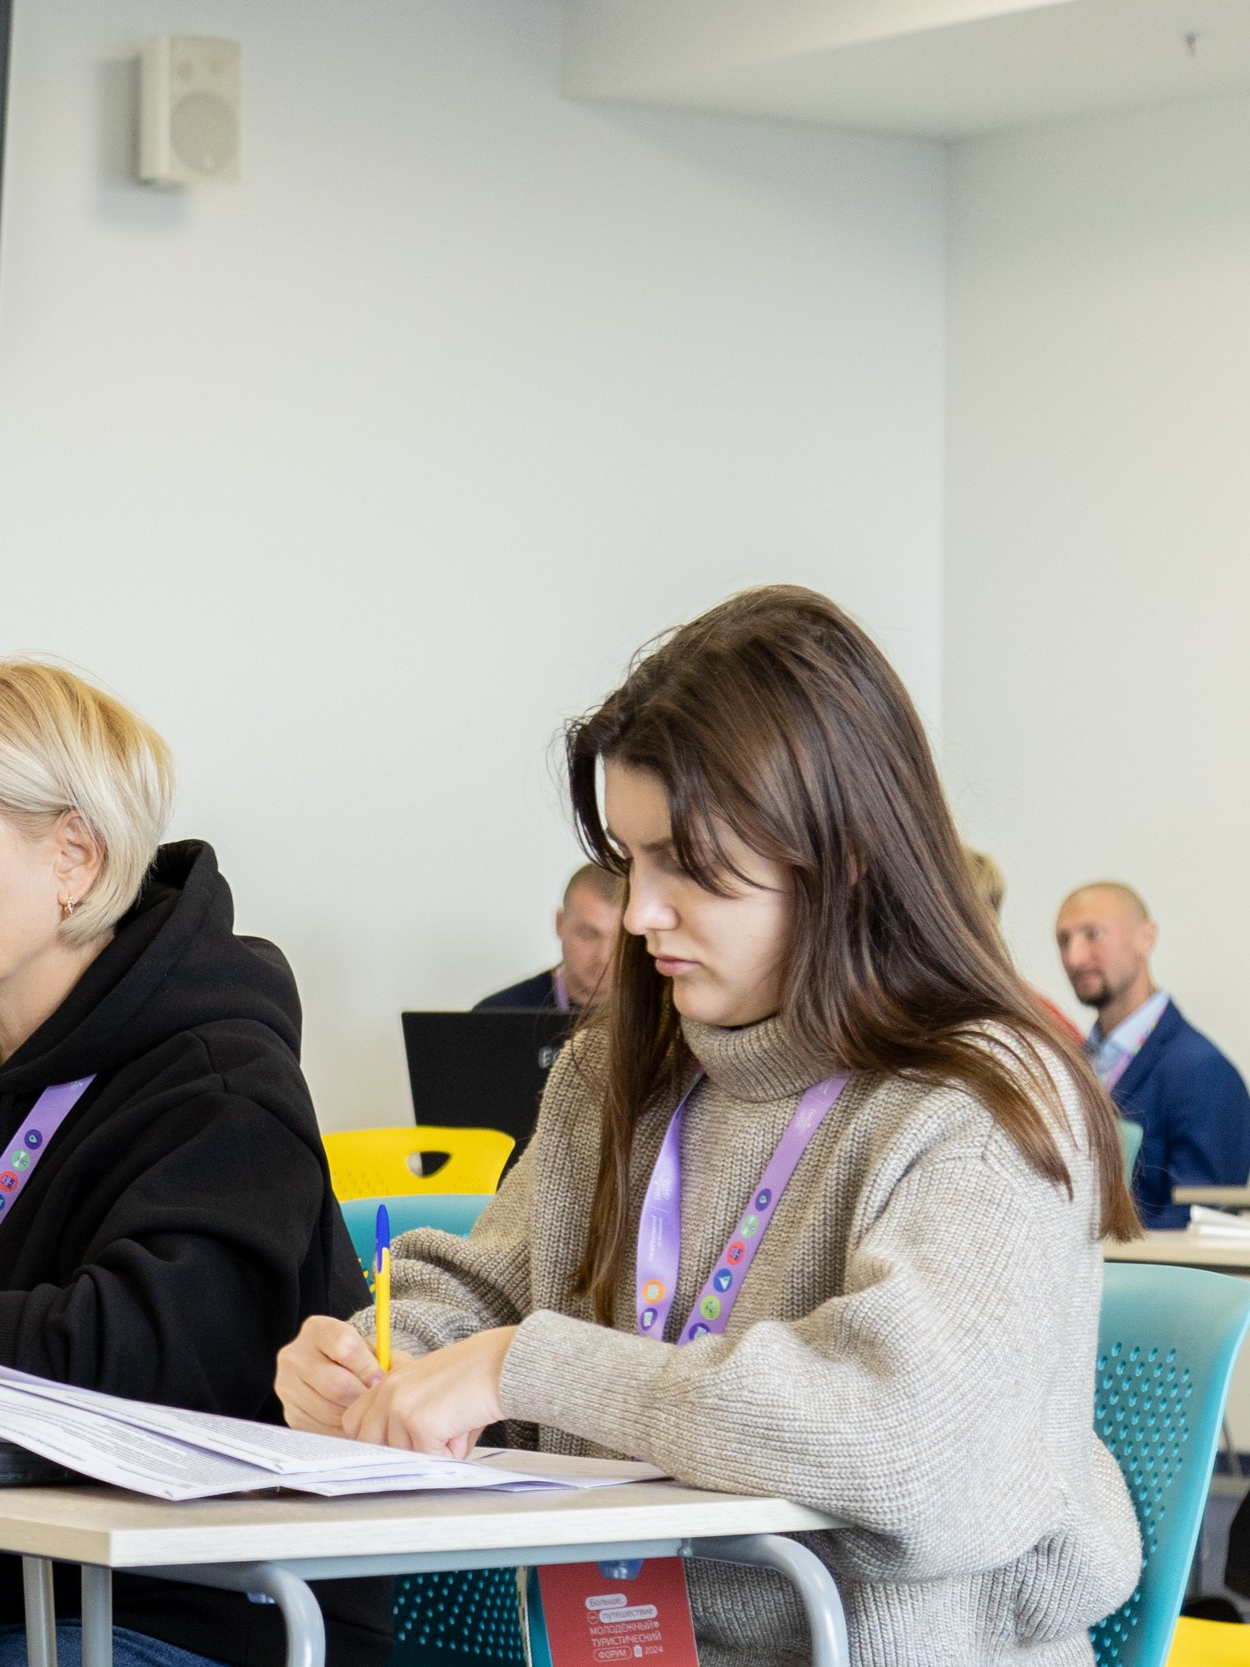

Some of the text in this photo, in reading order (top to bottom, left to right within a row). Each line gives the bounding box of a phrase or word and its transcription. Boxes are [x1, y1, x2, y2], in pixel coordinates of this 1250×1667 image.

[603, 1609, 654, 1620] путешествие
[592, 1632, 661, 1647] ТУРИСТИЧЕСКИЙ
[599, 1646, 663, 1659] ФОРУМ 2024
